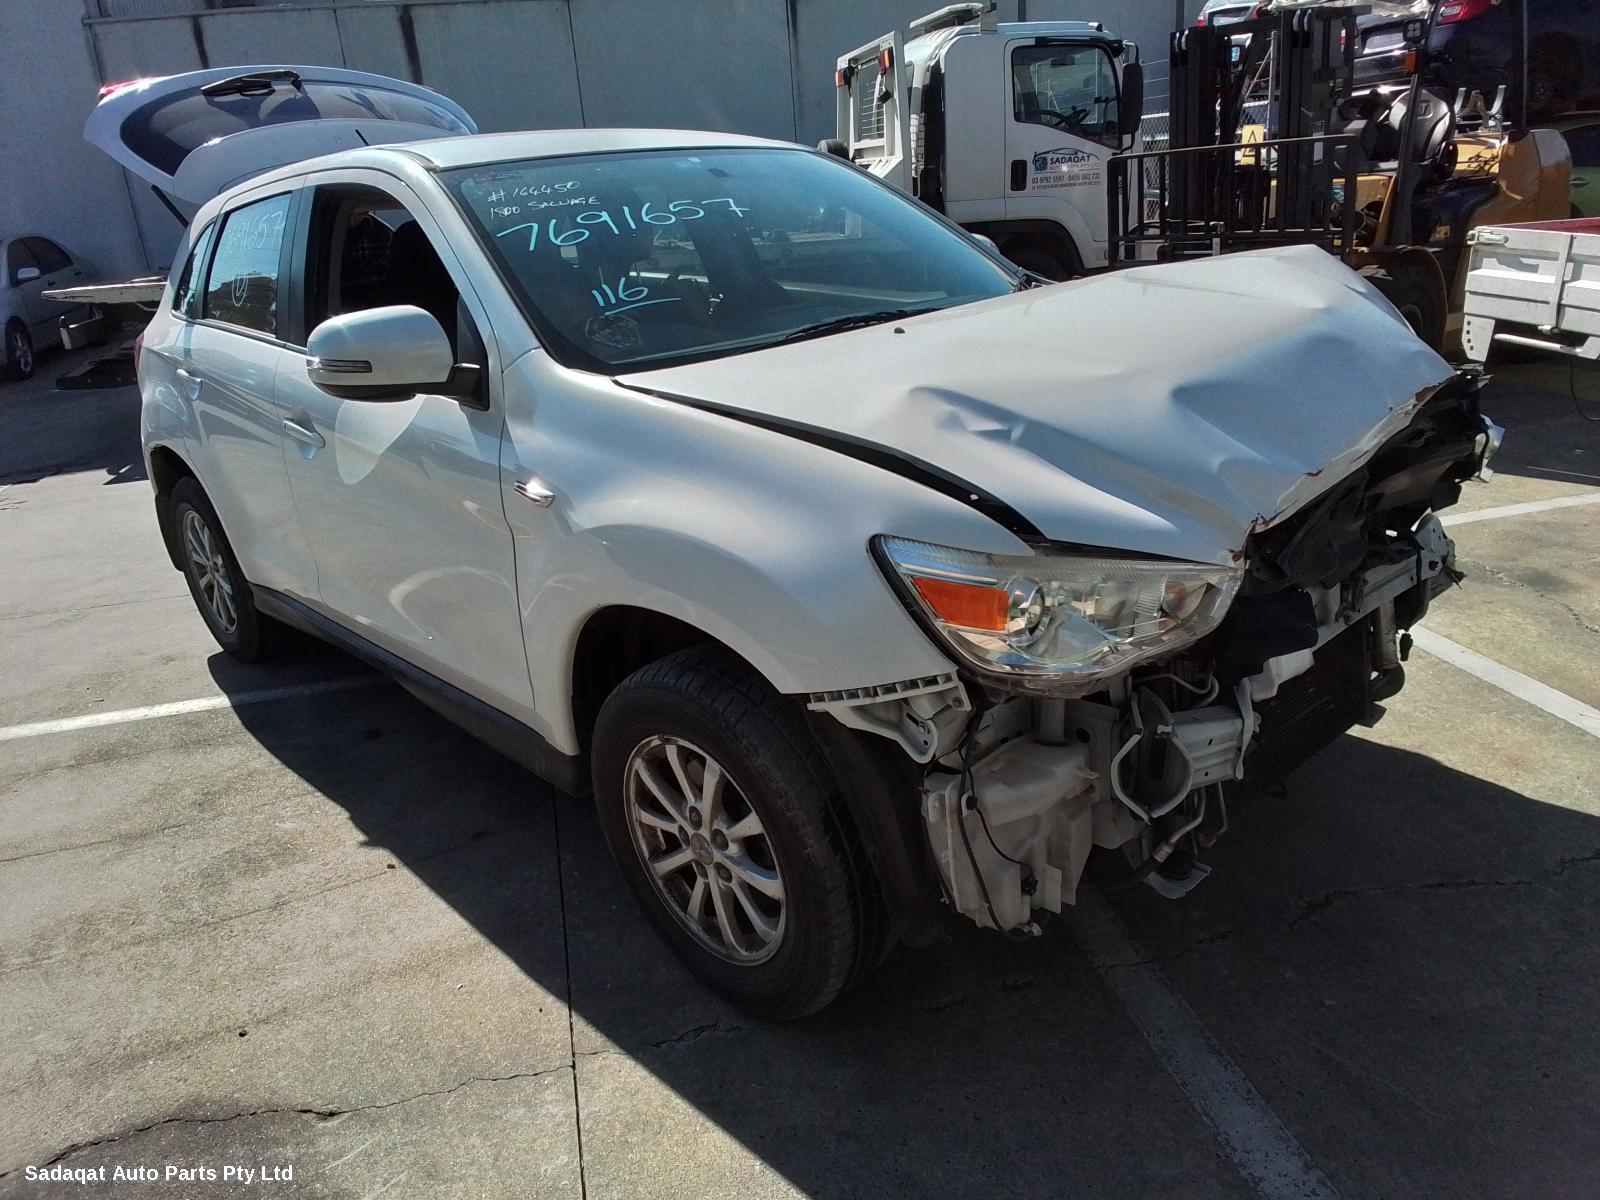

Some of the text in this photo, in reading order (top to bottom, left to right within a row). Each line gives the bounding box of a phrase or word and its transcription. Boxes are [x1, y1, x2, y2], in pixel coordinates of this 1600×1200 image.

[1049, 155, 1091, 165] SADAQAT
[511, 180, 582, 198] 164450
[496, 198, 750, 251] 7691657
[591, 276, 649, 307] 116
